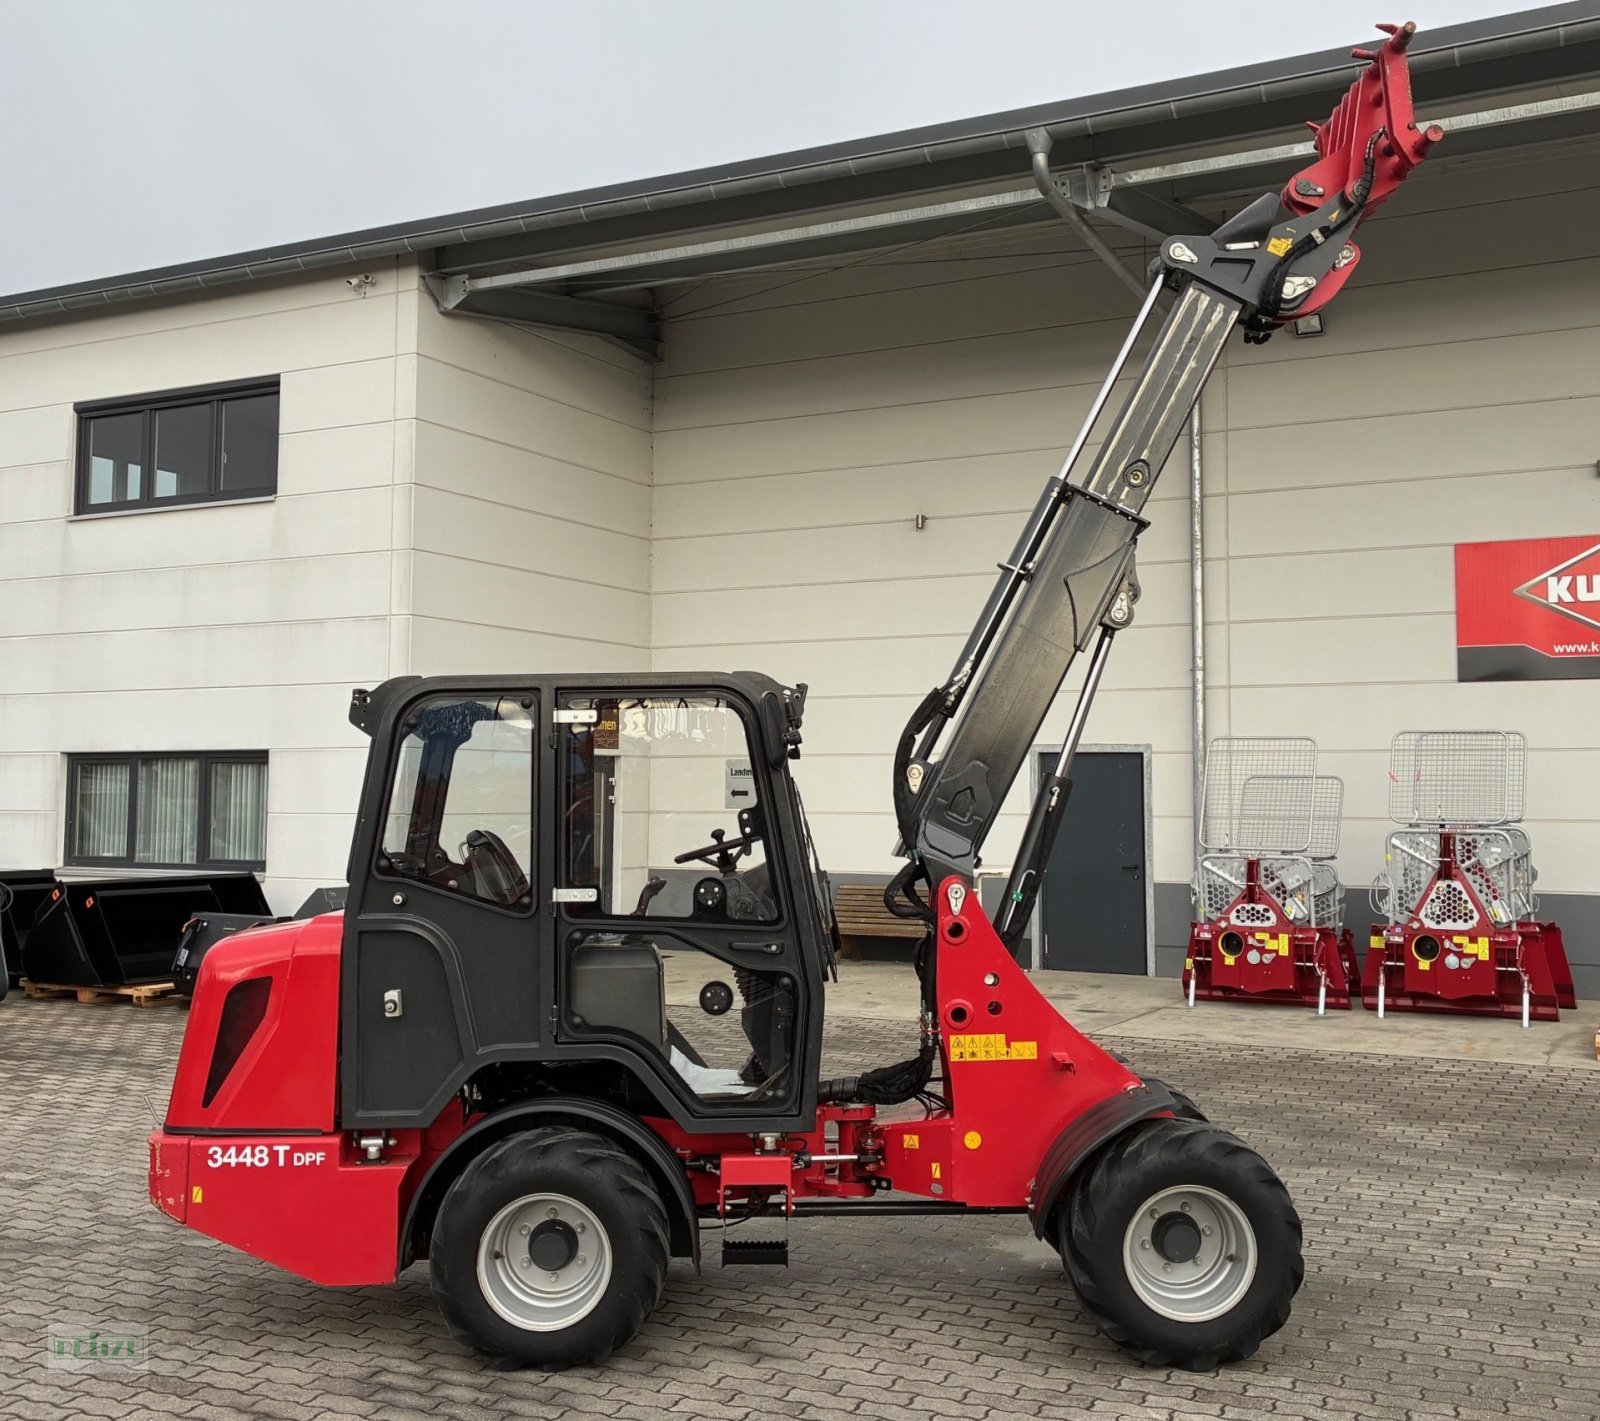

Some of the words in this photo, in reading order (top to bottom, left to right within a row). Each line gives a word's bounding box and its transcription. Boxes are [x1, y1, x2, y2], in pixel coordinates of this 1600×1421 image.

[207, 1145, 269, 1168] 3448
[273, 1145, 290, 1167] T
[293, 1152, 326, 1166] DPF
